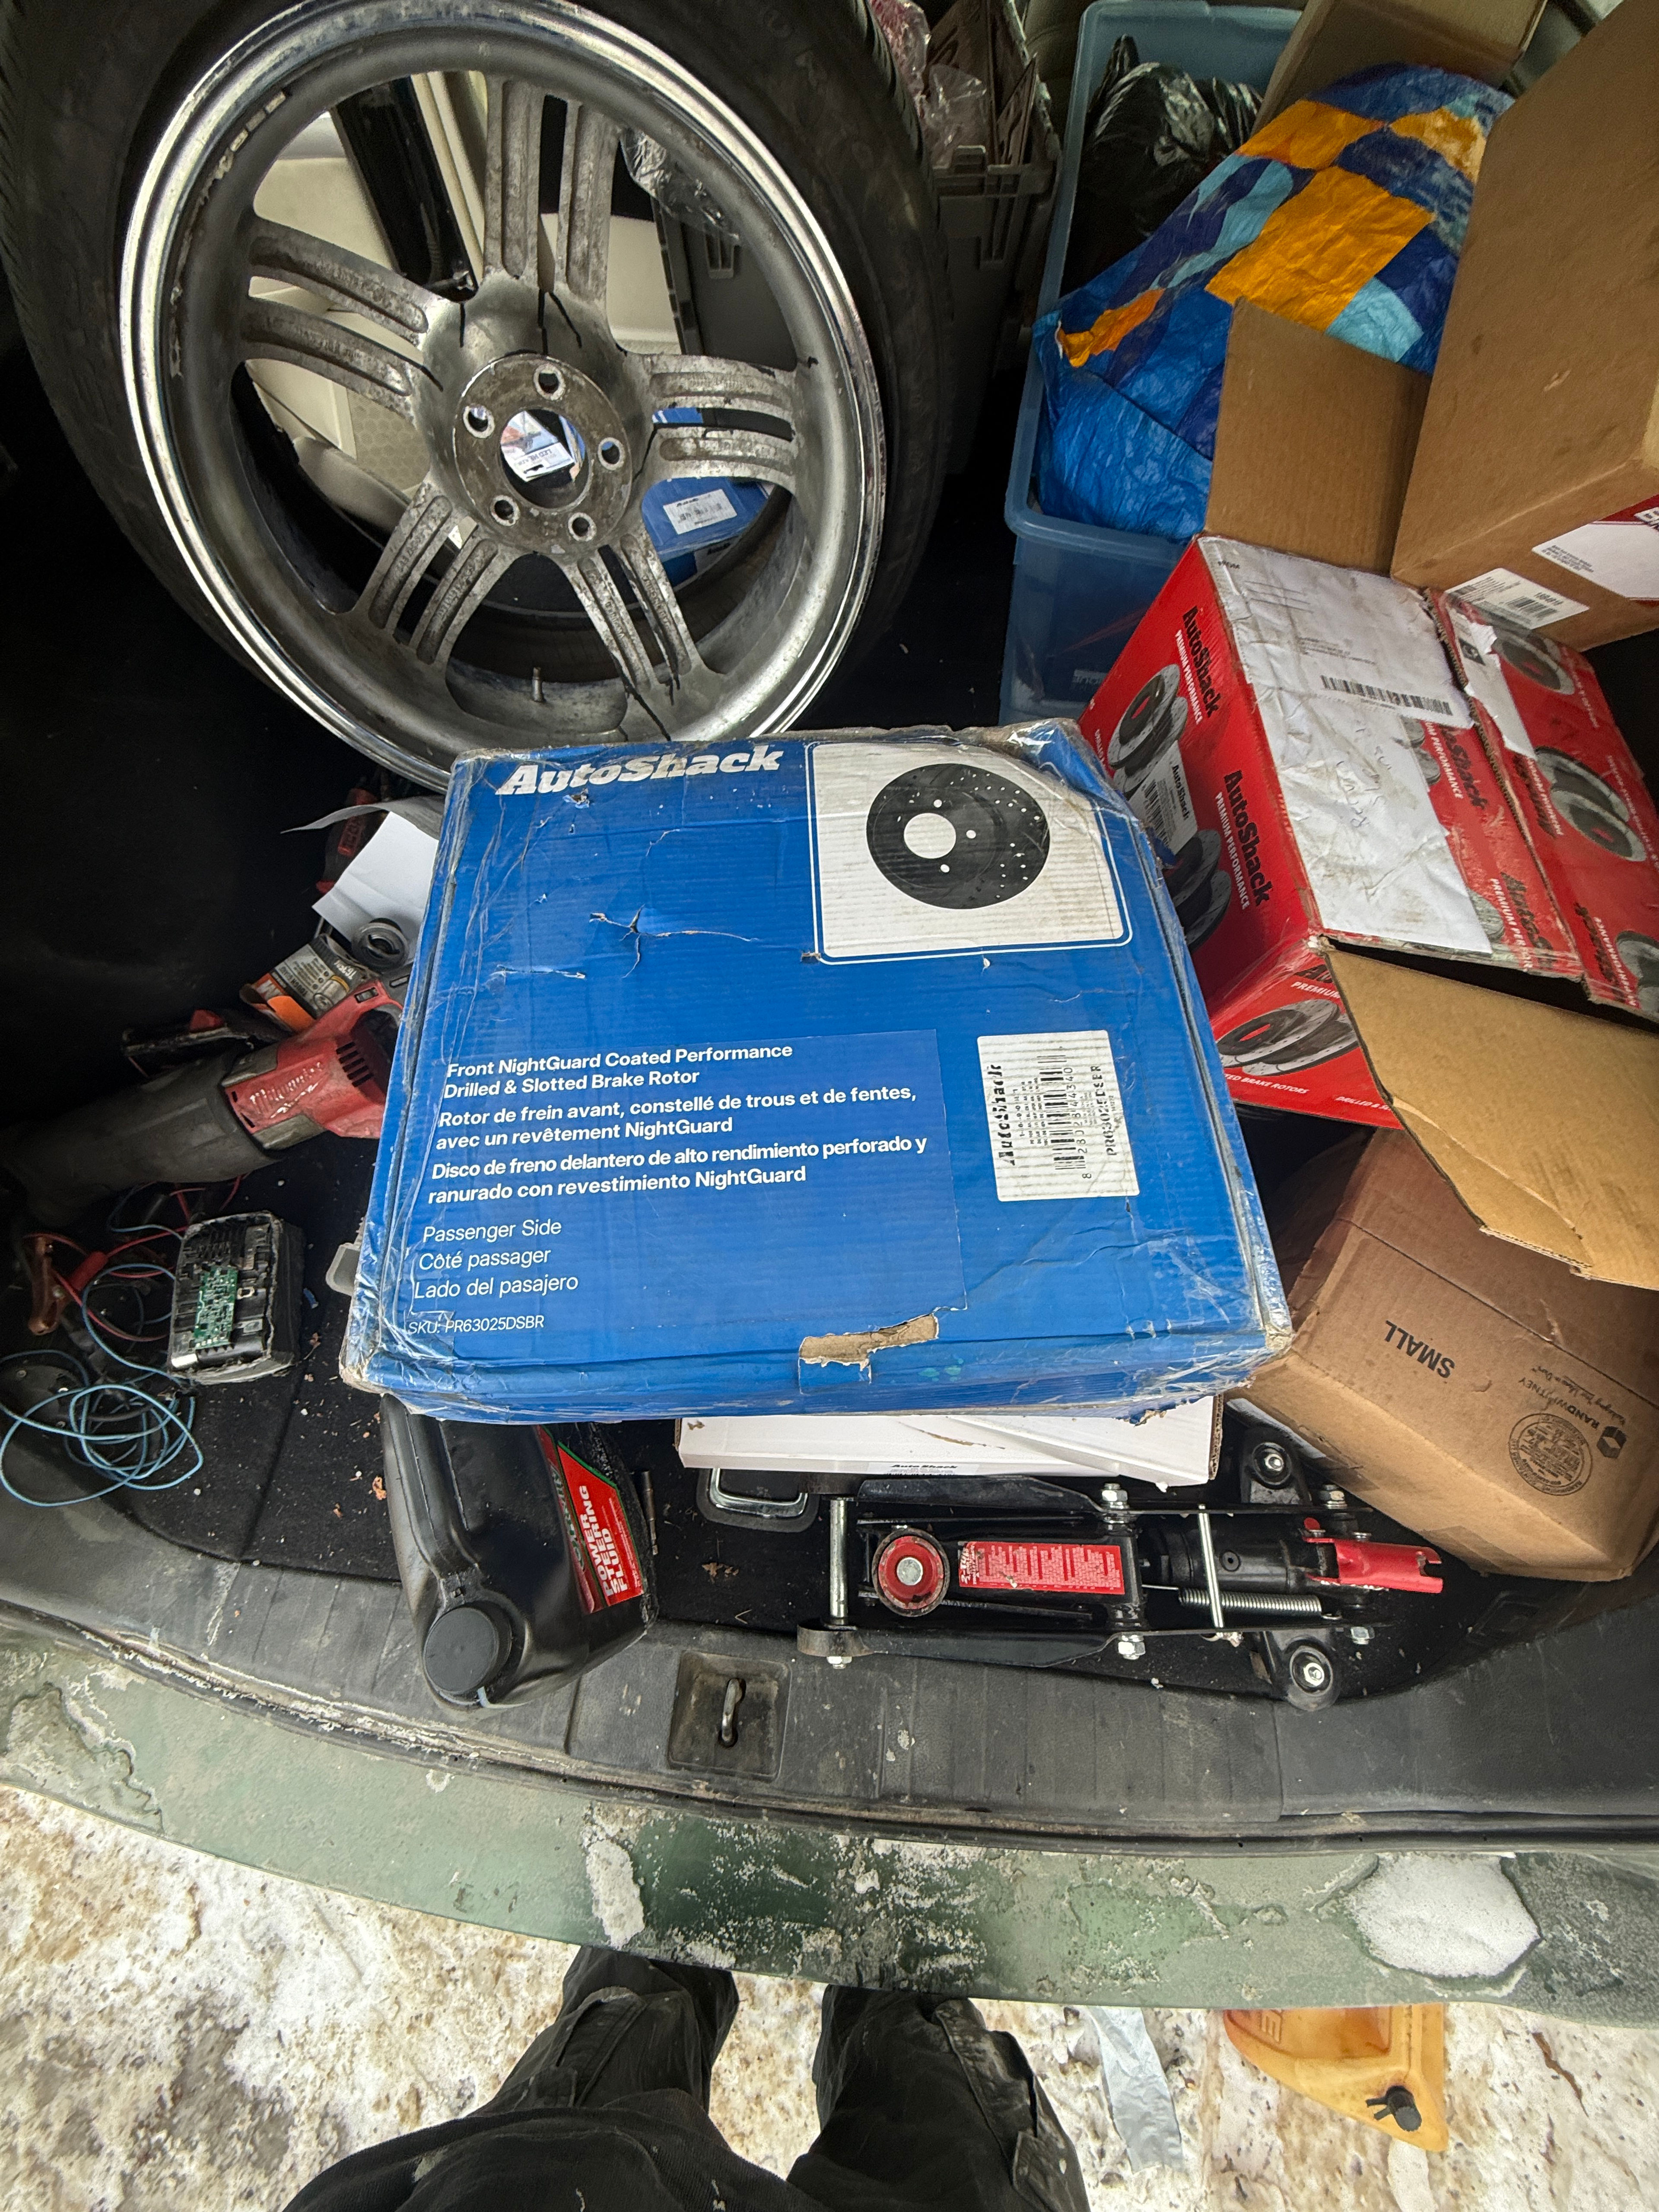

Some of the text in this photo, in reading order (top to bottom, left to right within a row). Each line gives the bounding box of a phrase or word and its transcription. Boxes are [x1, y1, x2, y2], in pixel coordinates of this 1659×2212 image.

[1182, 605, 1221, 718] AutoShack
[1183, 665, 1203, 725] PERFORMANCE
[495, 746, 784, 796] AutoShack
[1215, 791, 1251, 910] PREMIUM PERFORMANCE
[1224, 769, 1273, 906] AutoShack
[1490, 878, 1517, 926] PREMIUM
[447, 1046, 793, 1078] Front NightGuard Coated Performance
[443, 1070, 700, 1099] Drilled & Slotted Brake Rotor
[1240, 1077, 1270, 1087] BRAKE
[1271, 1083, 1310, 1094] ROTORS
[1335, 1096, 1371, 1106] DRILLED
[438, 1086, 917, 1128] Rotor de frein avant, constellé de trous et de fentes,
[435, 1117, 733, 1150] avec un revêtement NightGuard
[432, 1135, 928, 1180] Disco de freno delantero de alto rendimiento perforado y
[428, 1166, 807, 1205] ranurado con revestimiento NightGuard
[423, 1219, 562, 1243] Passenger Side
[419, 1249, 552, 1271] Côté passager
[414, 1274, 579, 1299] Lado del pasajero
[407, 1315, 545, 1335] SKU: PR63025DSBR
[1385, 1319, 1456, 1379] SMALL
[578, 1485, 622, 1594] STEERING
[579, 1513, 613, 1597] POWER
[600, 1528, 629, 1592] FLUID
